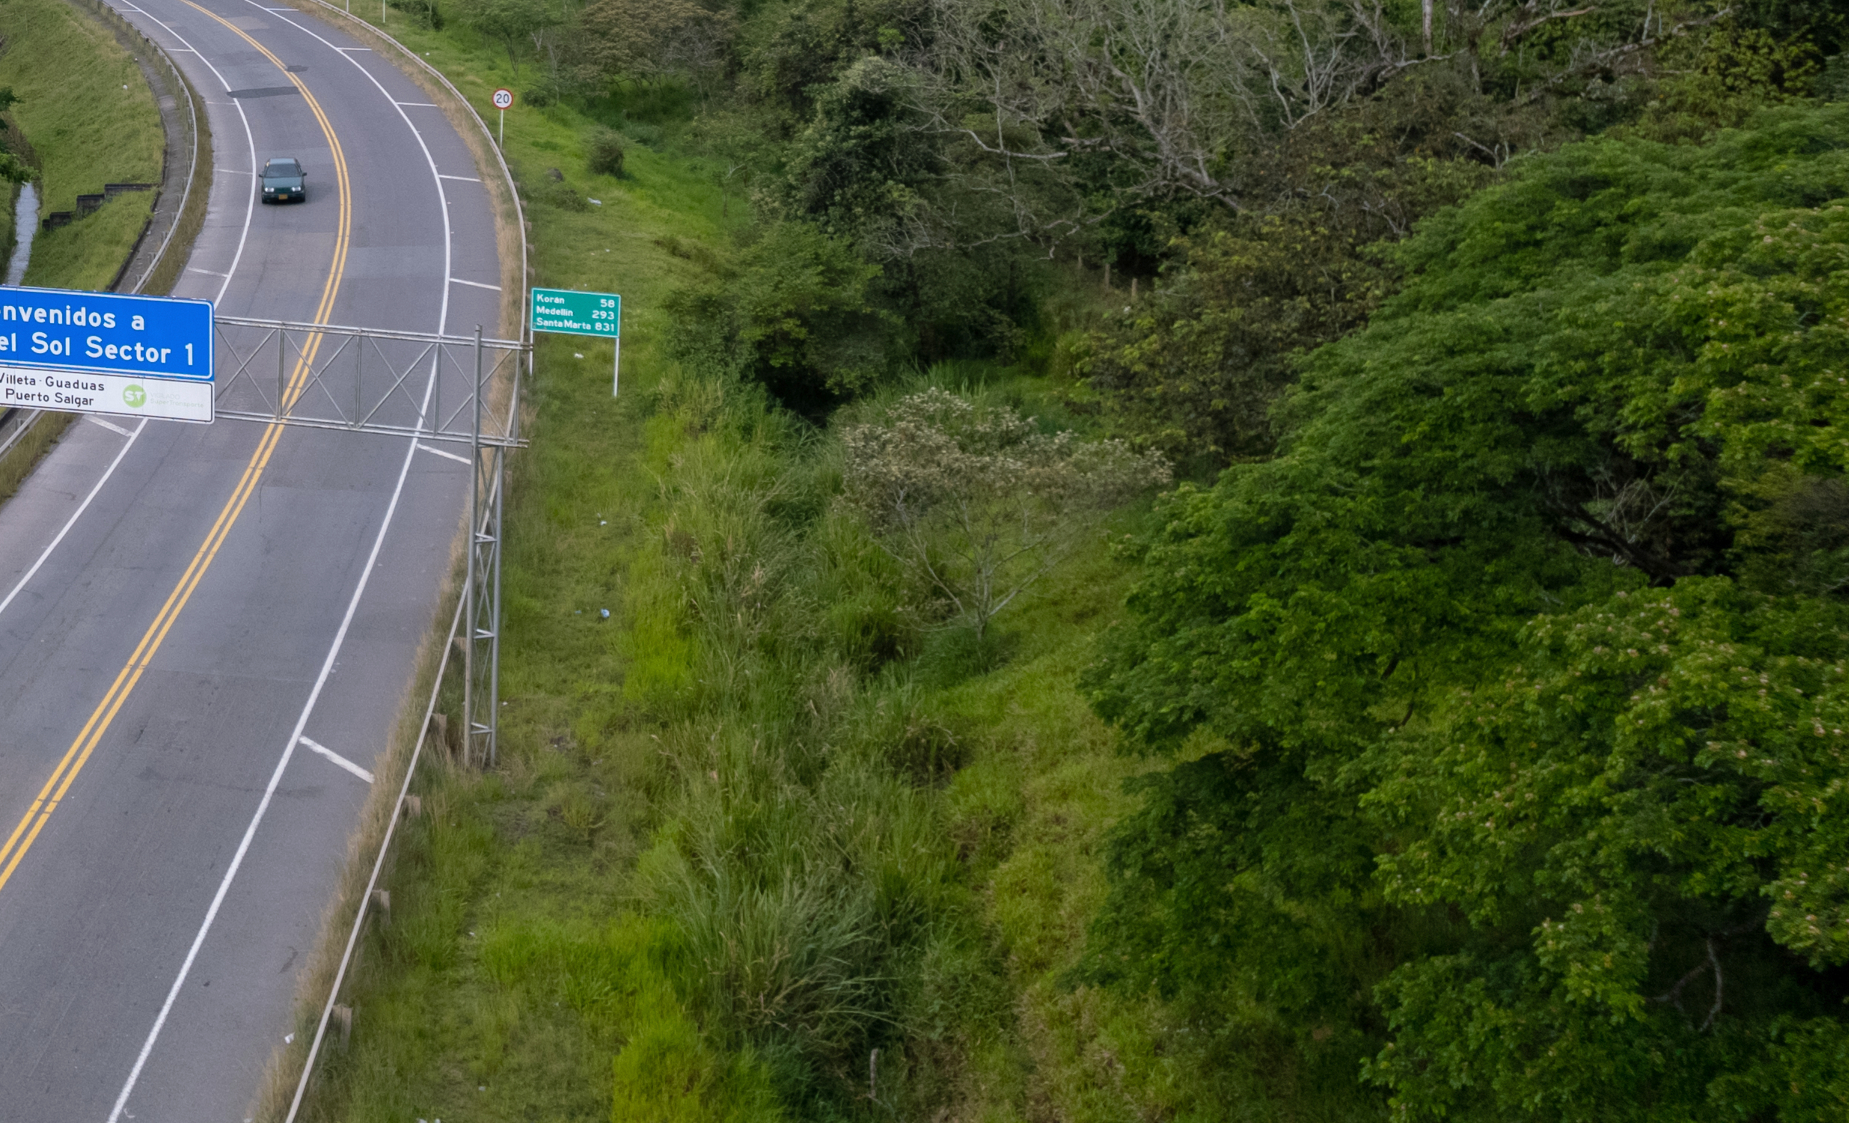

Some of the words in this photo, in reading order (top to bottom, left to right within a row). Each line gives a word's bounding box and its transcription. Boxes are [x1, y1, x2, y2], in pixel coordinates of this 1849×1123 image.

[496, 93, 510, 104] 20
[600, 298, 615, 308] 58
[131, 314, 145, 331] a
[592, 310, 615, 320] 293
[536, 317, 563, 328] Santa
[564, 319, 591, 330] Marta
[595, 322, 614, 332] 831
[31, 331, 70, 356] Sol
[85, 335, 171, 364] Sector
[185, 342, 193, 366] 1
[45, 375, 105, 392] Guaduas
[5, 388, 50, 403] Puerto
[54, 392, 94, 408] Salgar
[124, 390, 145, 403] ST
